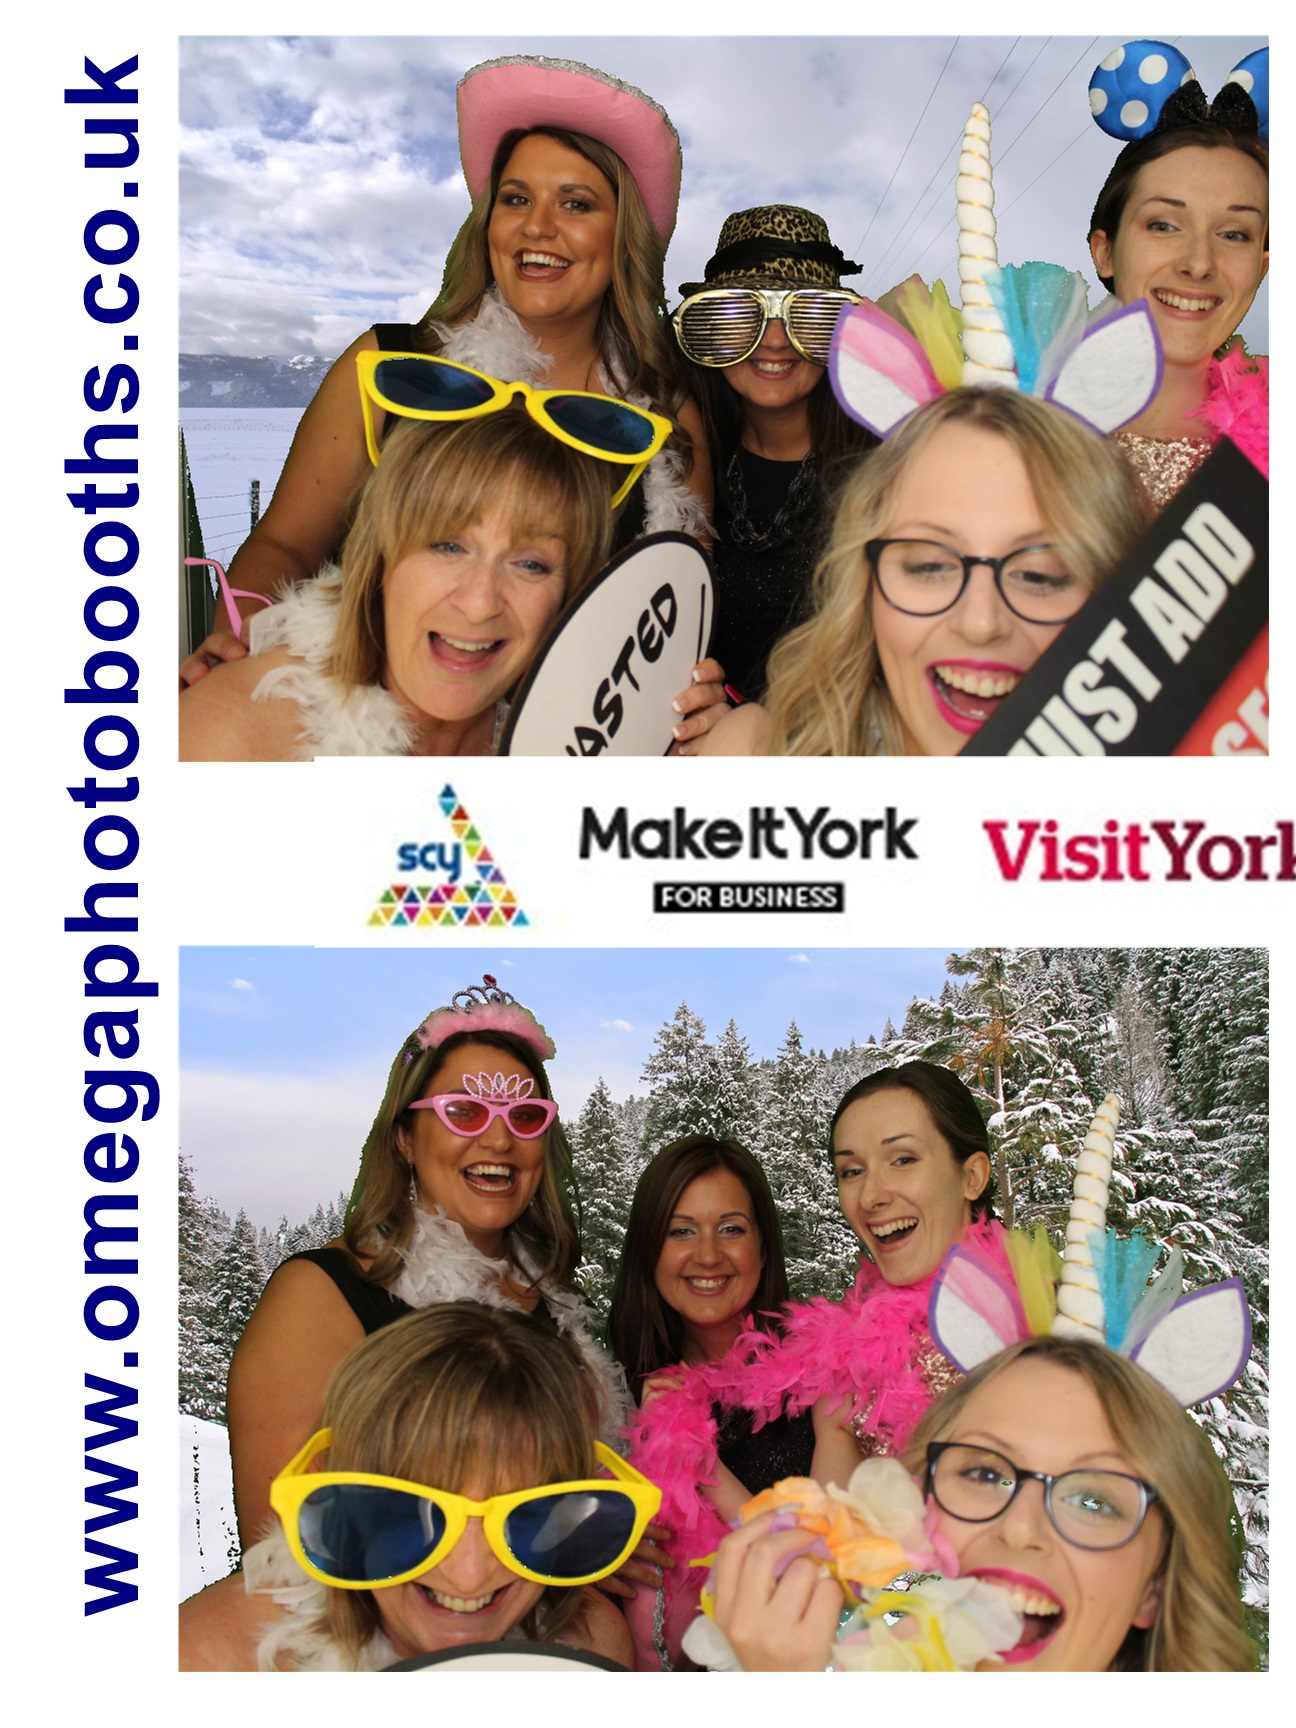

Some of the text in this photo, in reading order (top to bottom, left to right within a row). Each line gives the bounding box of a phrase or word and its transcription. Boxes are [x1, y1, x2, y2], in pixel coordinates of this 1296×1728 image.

[565, 582, 678, 757] ASTED
[1006, 502, 1255, 757] UST ADD
